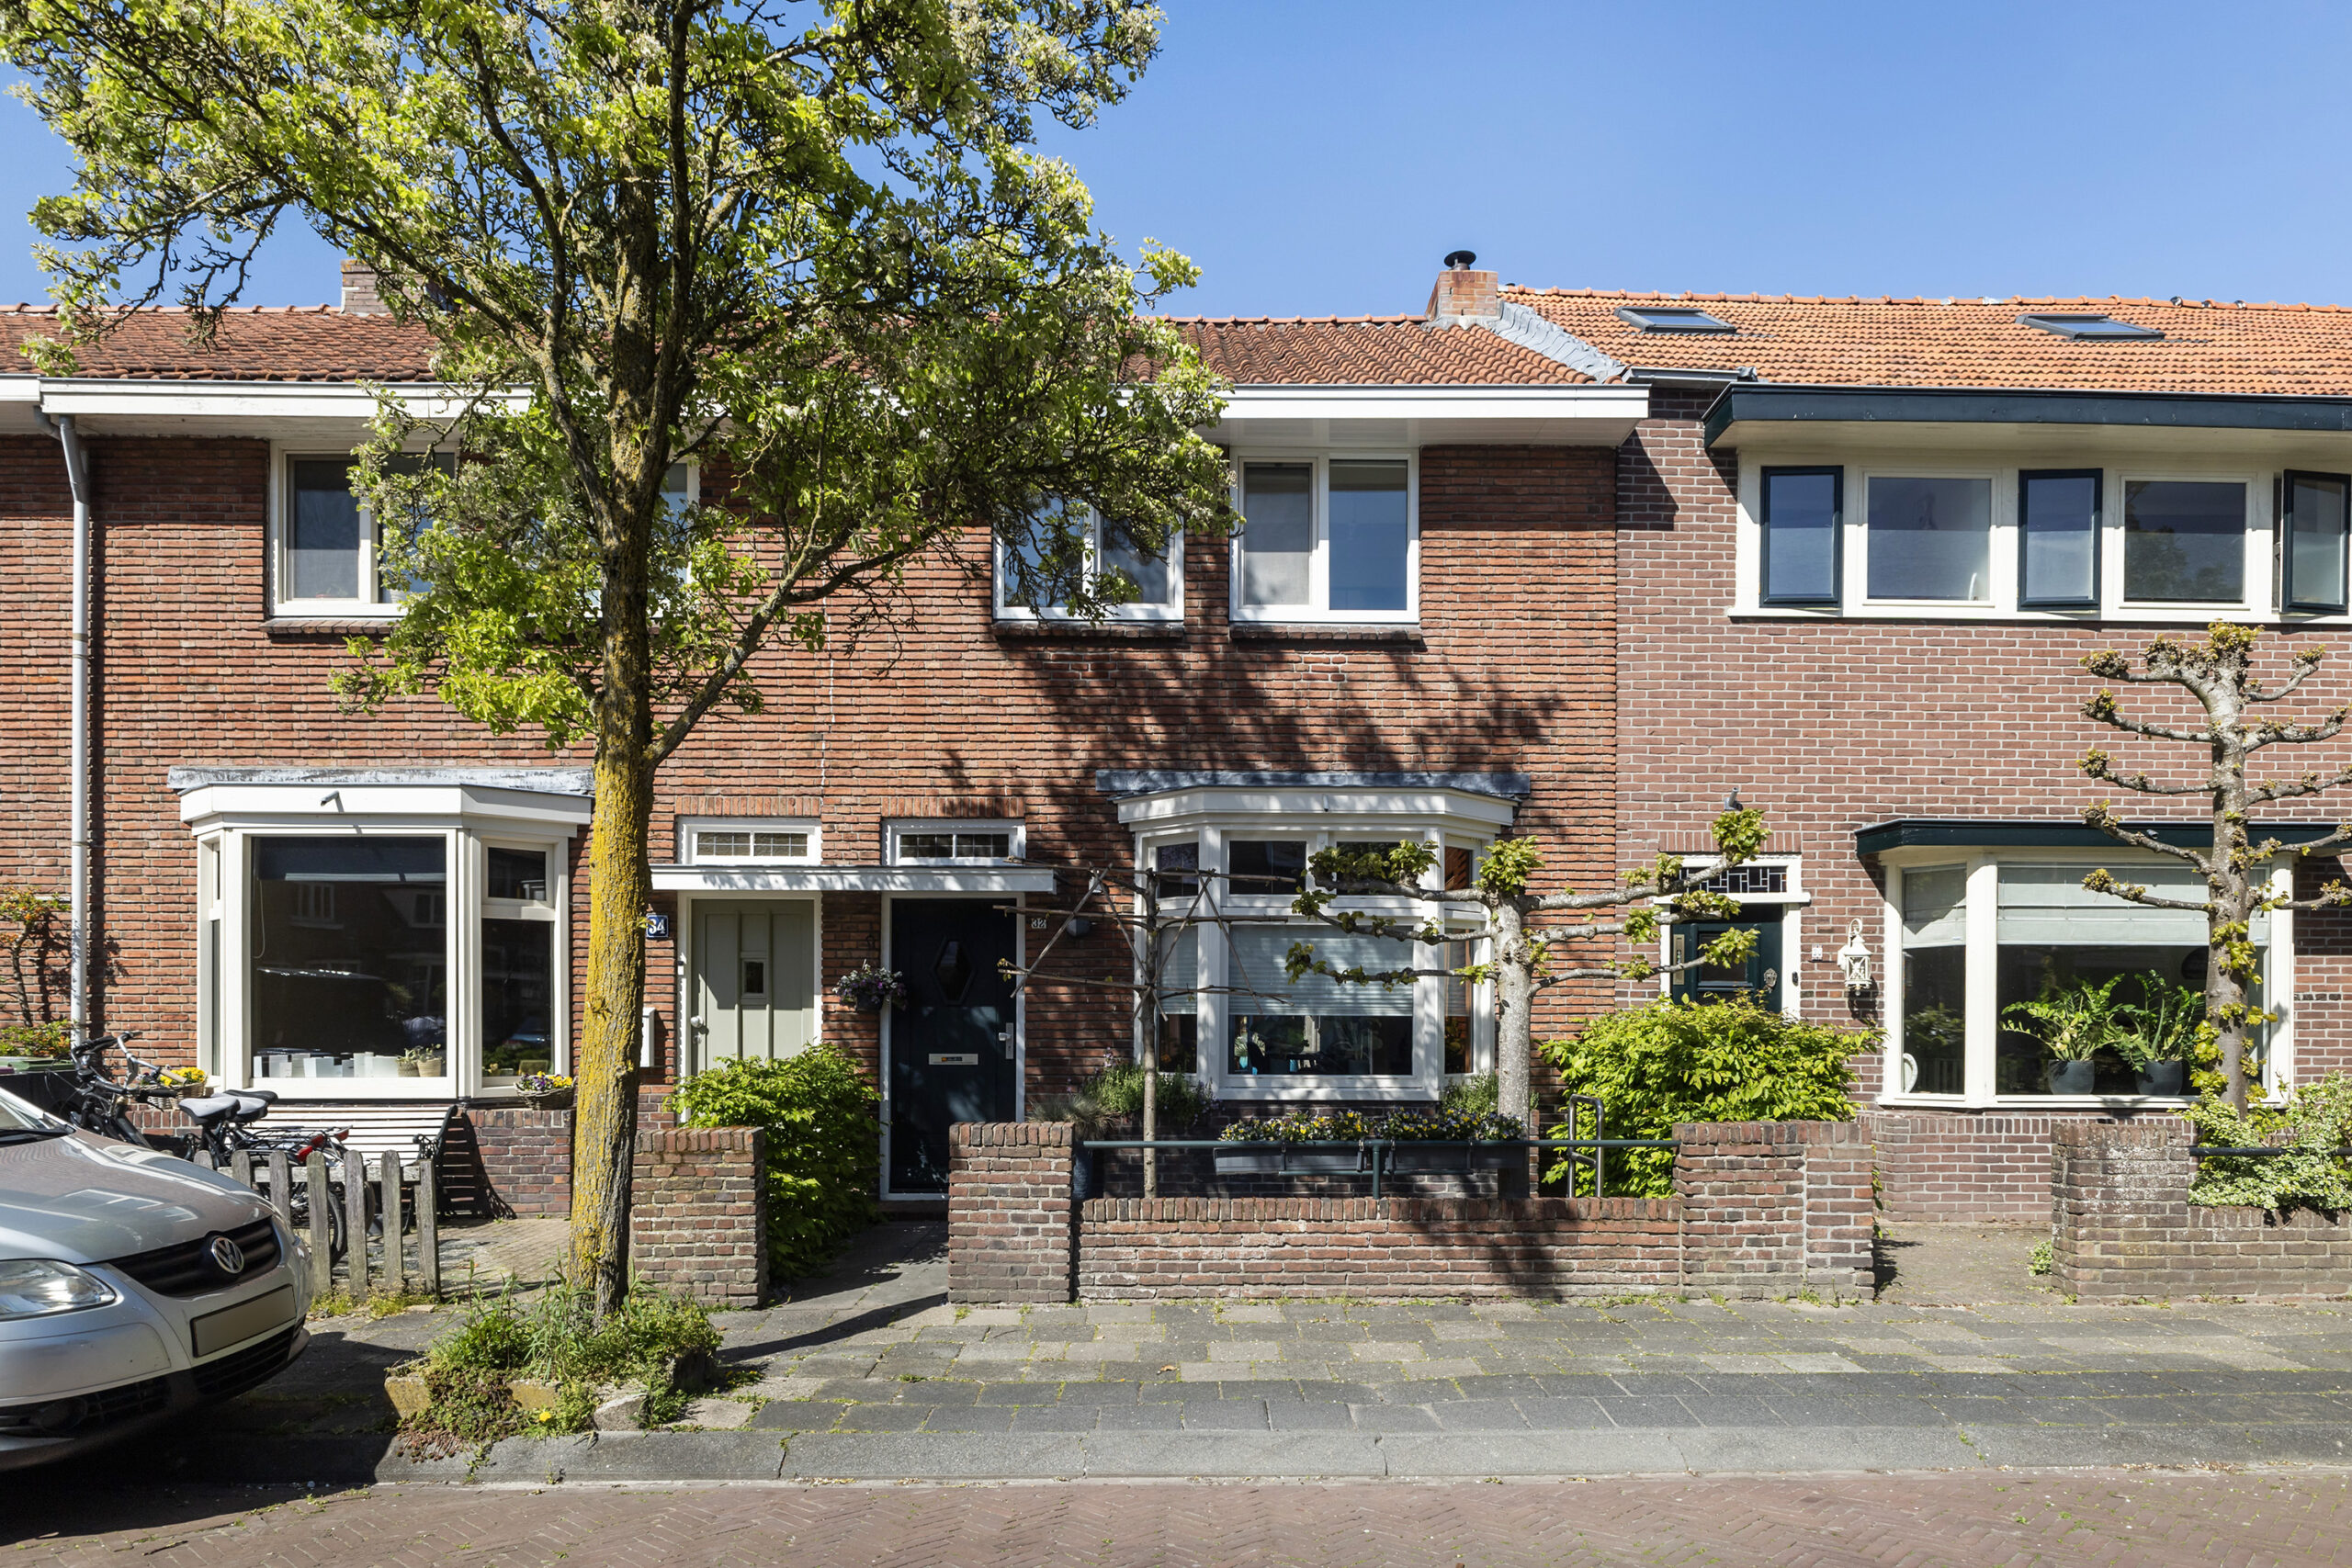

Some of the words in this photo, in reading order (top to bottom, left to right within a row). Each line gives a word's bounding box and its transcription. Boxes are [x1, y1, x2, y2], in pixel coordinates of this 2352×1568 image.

[648, 918, 666, 934] 34
[1032, 918, 1046, 928] 32
[212, 1236, 243, 1273] VW
